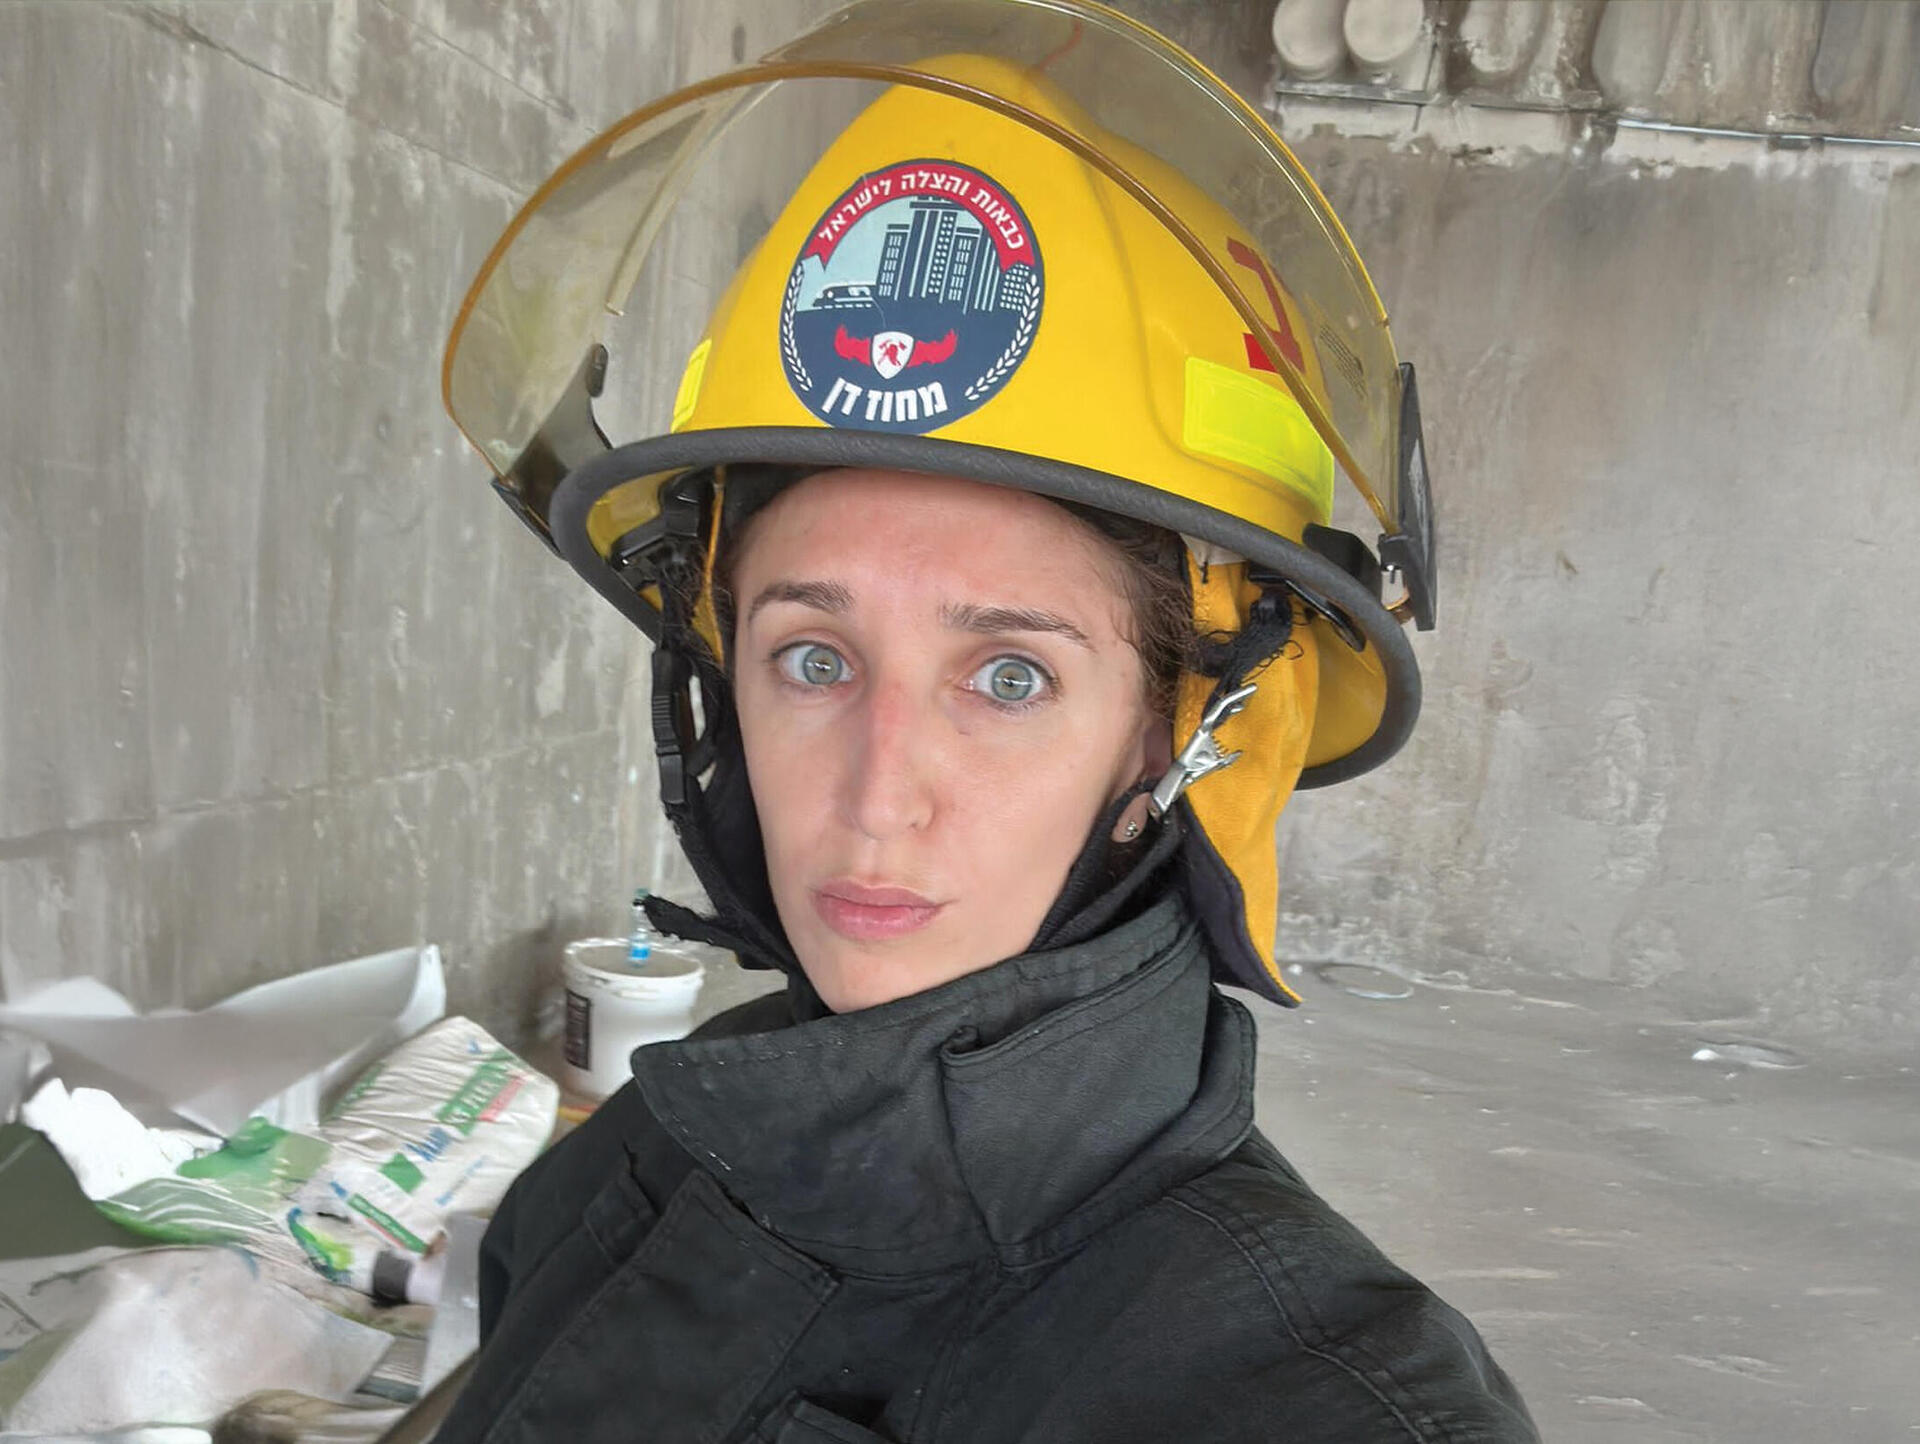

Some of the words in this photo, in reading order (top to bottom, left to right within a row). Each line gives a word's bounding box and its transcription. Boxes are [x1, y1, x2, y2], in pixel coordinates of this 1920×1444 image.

[901, 170, 971, 196] והצלה
[818, 178, 892, 242] לישראל
[970, 188, 1025, 249] כבאות
[821, 377, 863, 416] דן
[865, 381, 948, 422] מחוז
